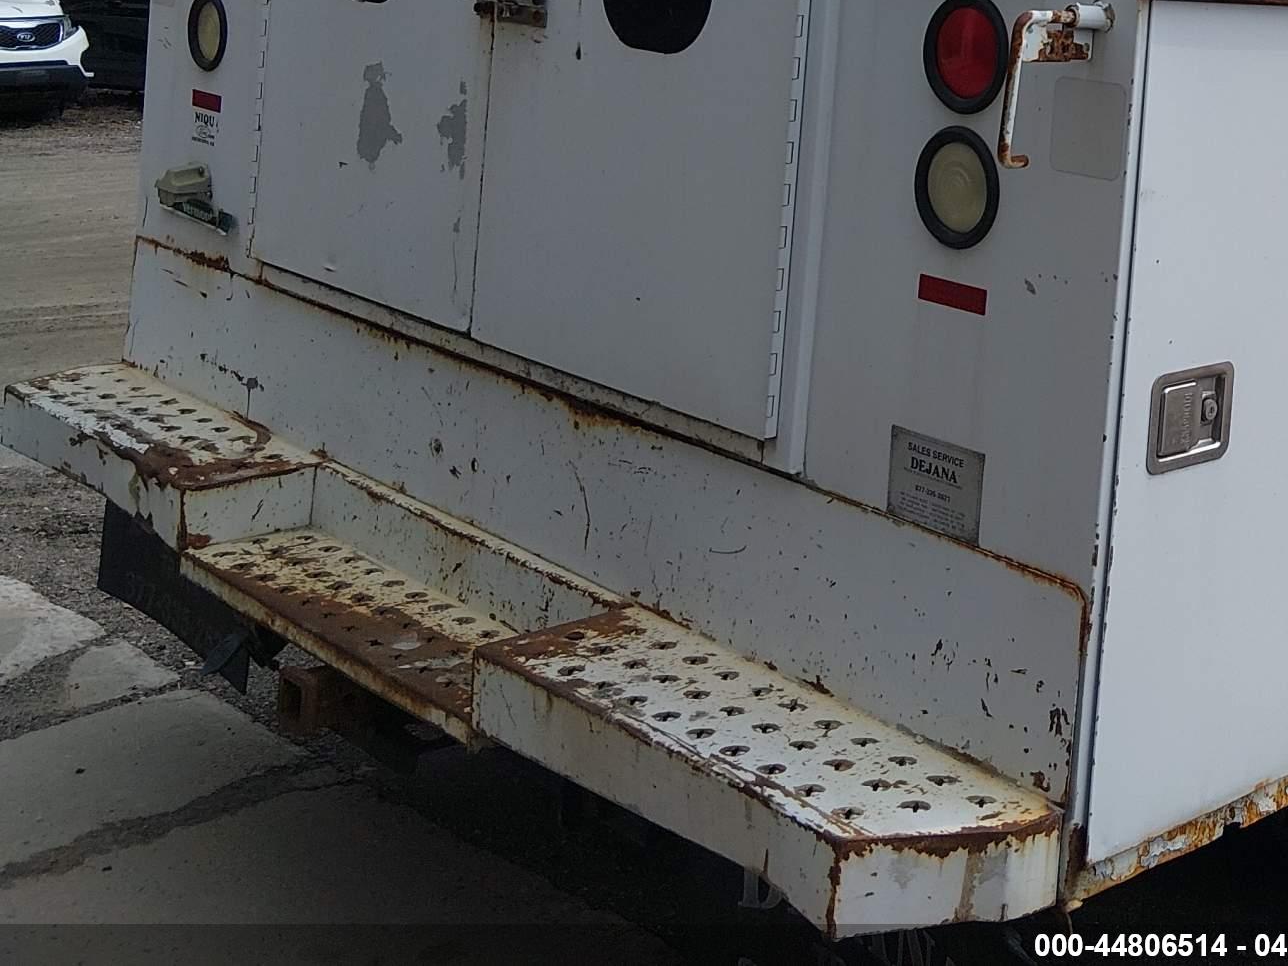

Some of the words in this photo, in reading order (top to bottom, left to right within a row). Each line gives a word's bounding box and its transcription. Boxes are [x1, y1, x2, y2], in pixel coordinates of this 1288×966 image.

[907, 441, 931, 457] SALES
[932, 450, 965, 468] SERVICE
[910, 456, 958, 484] DEJANA
